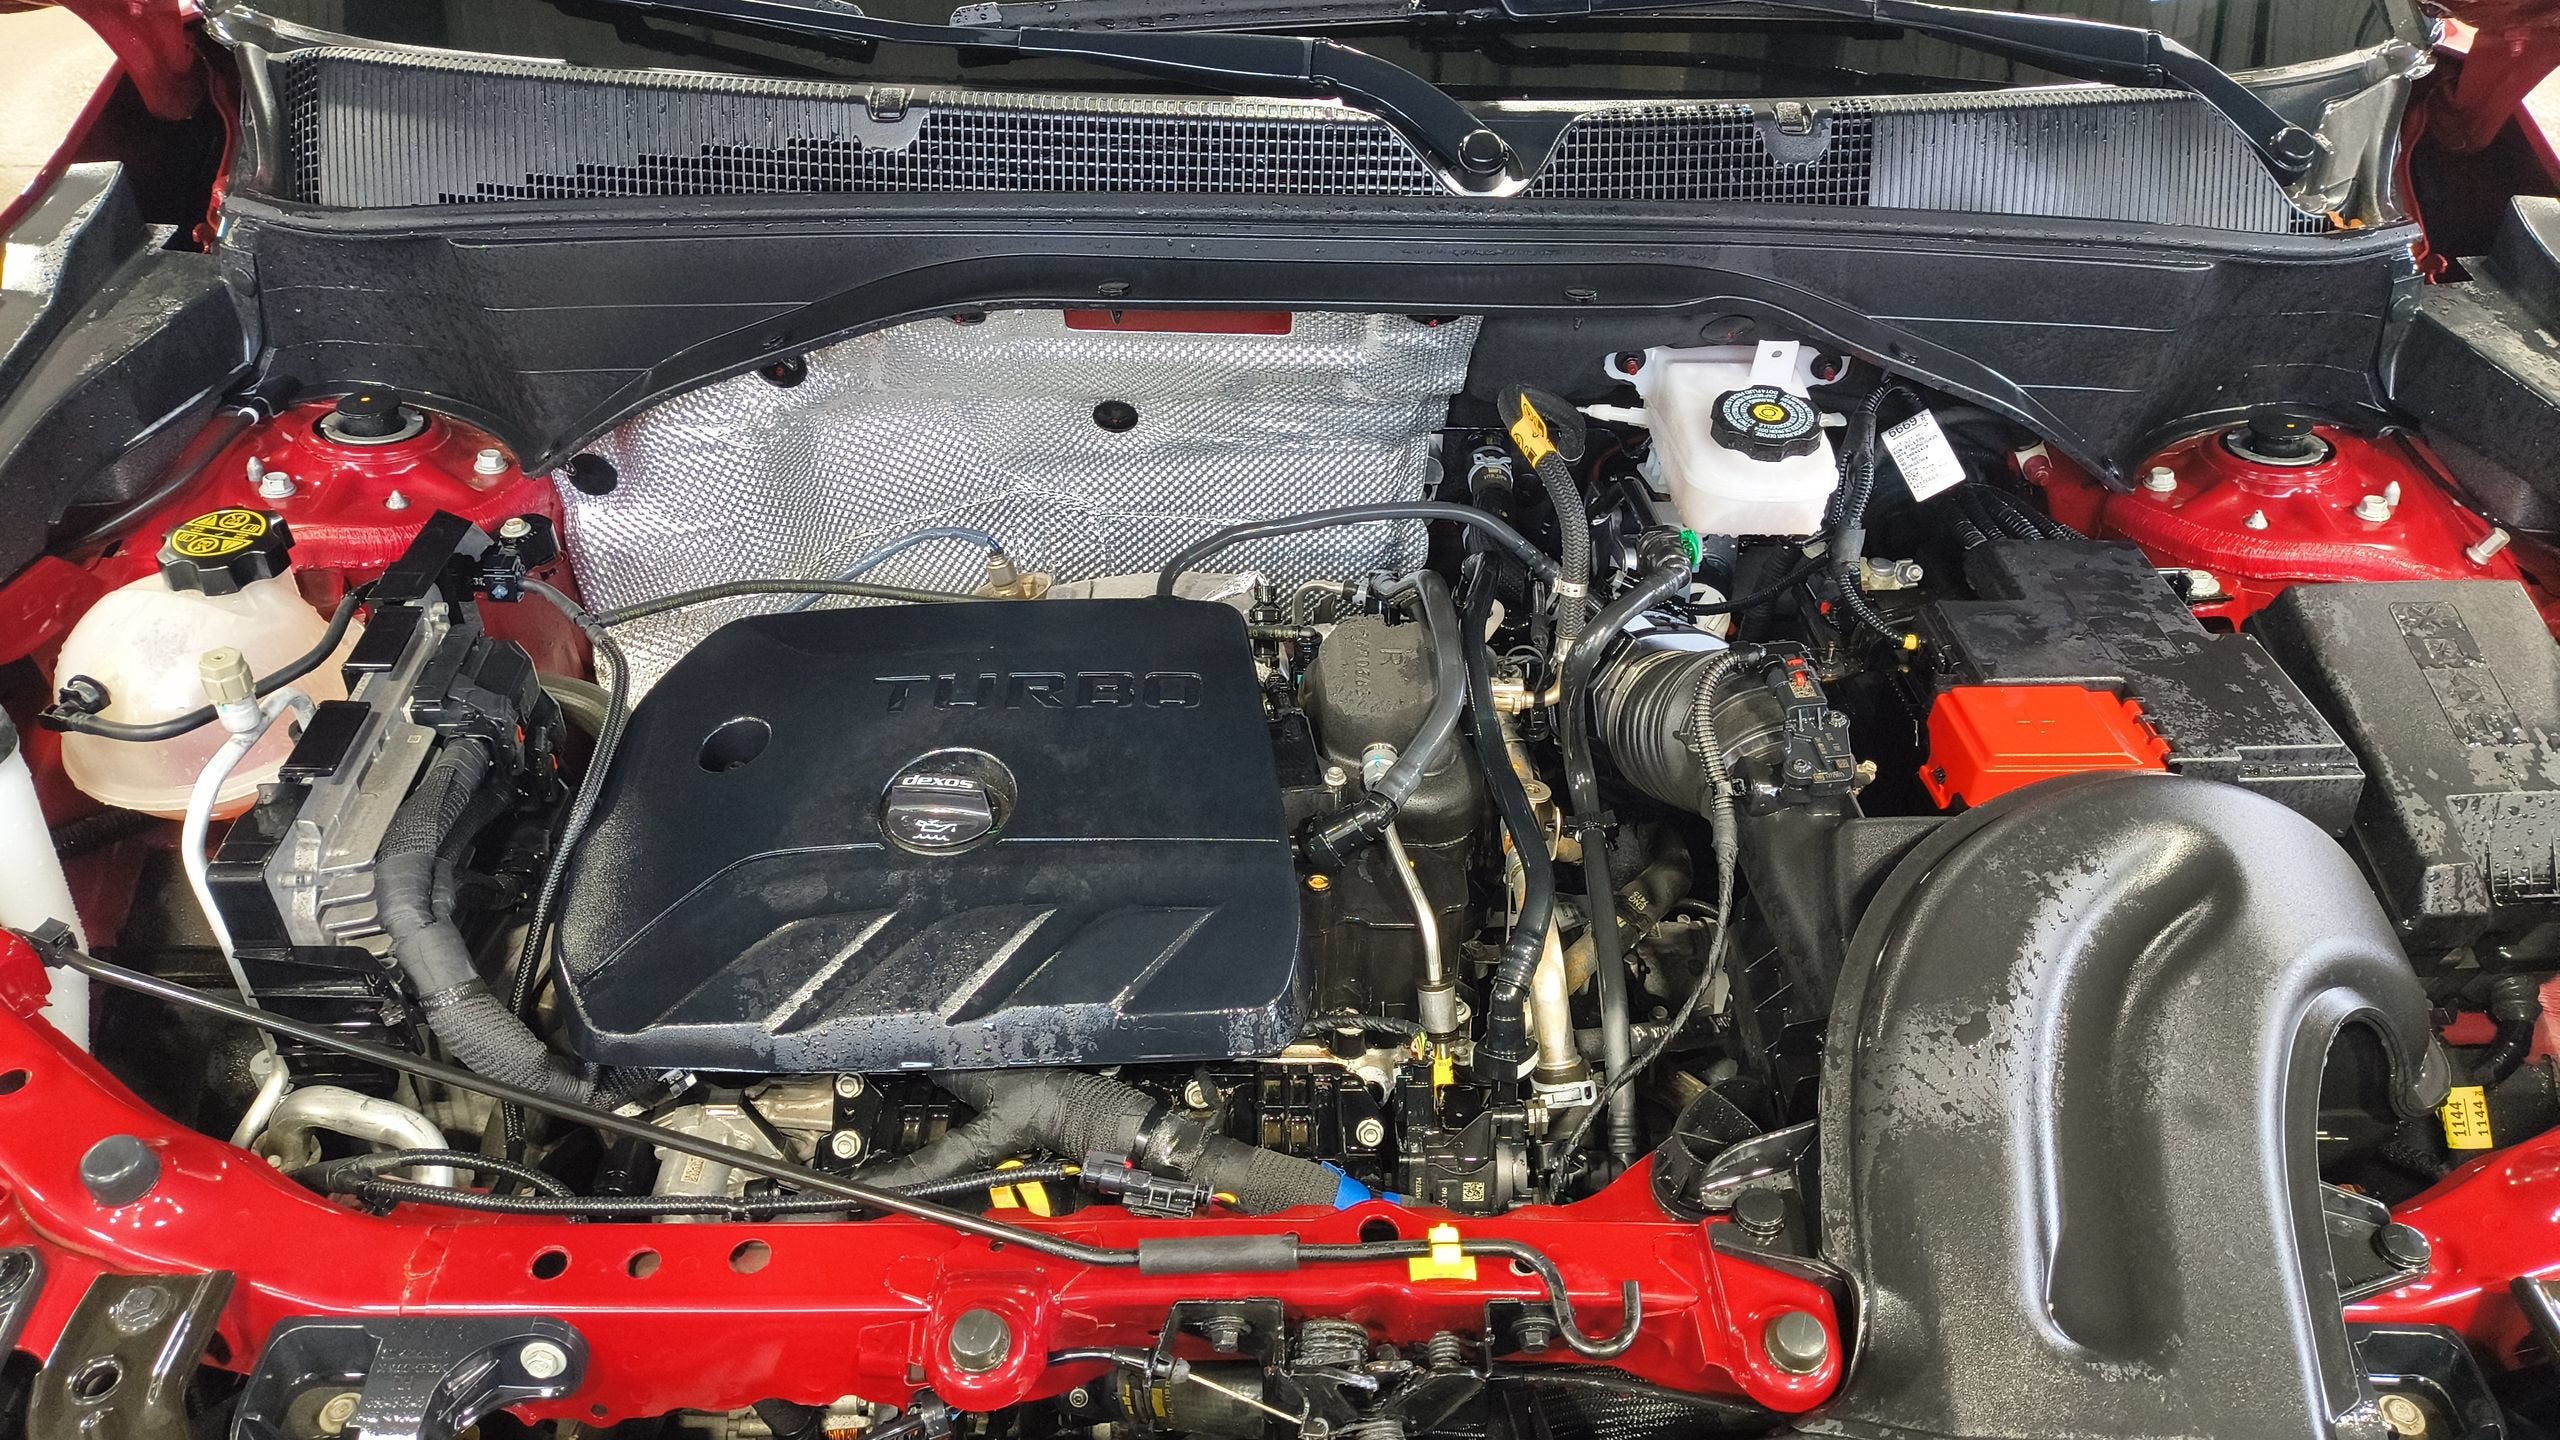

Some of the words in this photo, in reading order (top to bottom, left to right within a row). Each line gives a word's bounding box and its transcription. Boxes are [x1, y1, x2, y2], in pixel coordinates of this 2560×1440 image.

[1888, 417, 1918, 437] 6669
[873, 671, 1203, 712] TURBO
[901, 774, 978, 789] dexos
[2449, 1102, 2467, 1137] 1144
[2473, 1102, 2489, 1136] 1144
